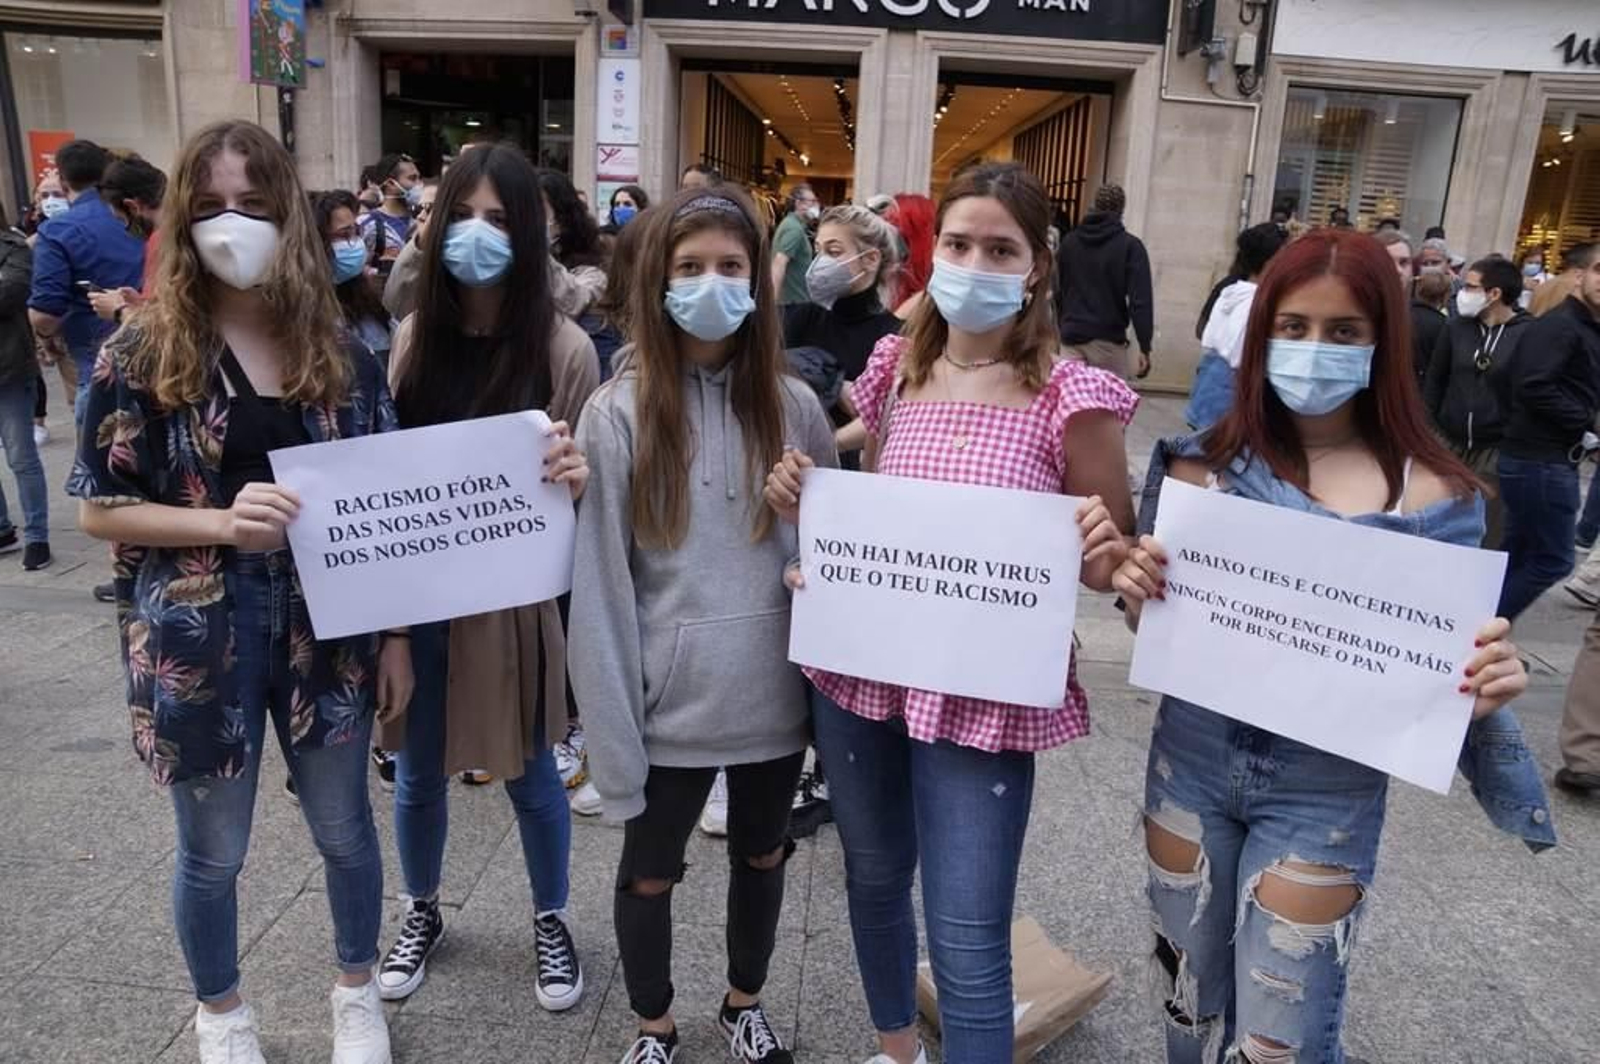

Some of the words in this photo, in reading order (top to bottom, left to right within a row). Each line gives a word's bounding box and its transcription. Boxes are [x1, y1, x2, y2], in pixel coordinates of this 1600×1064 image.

[328, 521, 373, 543] DAS
[377, 508, 452, 535] NOSAS
[456, 494, 532, 520] VIDAS,
[334, 486, 441, 516] RACISMO
[446, 474, 511, 499] FÓRA
[324, 547, 370, 569] DOS
[374, 534, 450, 561] NOSOS
[454, 516, 546, 546] CORPOS
[815, 538, 856, 557] NON
[862, 545, 899, 564] HAI
[905, 549, 978, 575] MAIOR
[985, 561, 1051, 585] VIRUS
[820, 563, 861, 583] QUE
[867, 571, 883, 586] O
[887, 573, 929, 593] TEU
[935, 579, 1038, 608] RACISMO
[1178, 548, 1245, 575] ABAIXO
[1249, 567, 1290, 588] CIES
[1295, 579, 1307, 593] E
[1312, 584, 1455, 632] CONCERTINAS
[1168, 581, 1227, 608] NINGÚN
[1230, 600, 1287, 626] CORPO
[1291, 617, 1401, 658] ENCERRADO
[1405, 650, 1452, 674] MÁIS
[1210, 611, 1242, 631] POR
[1245, 622, 1332, 657] BUSCARSE
[1335, 650, 1349, 663] O
[1352, 655, 1386, 674] PAN
